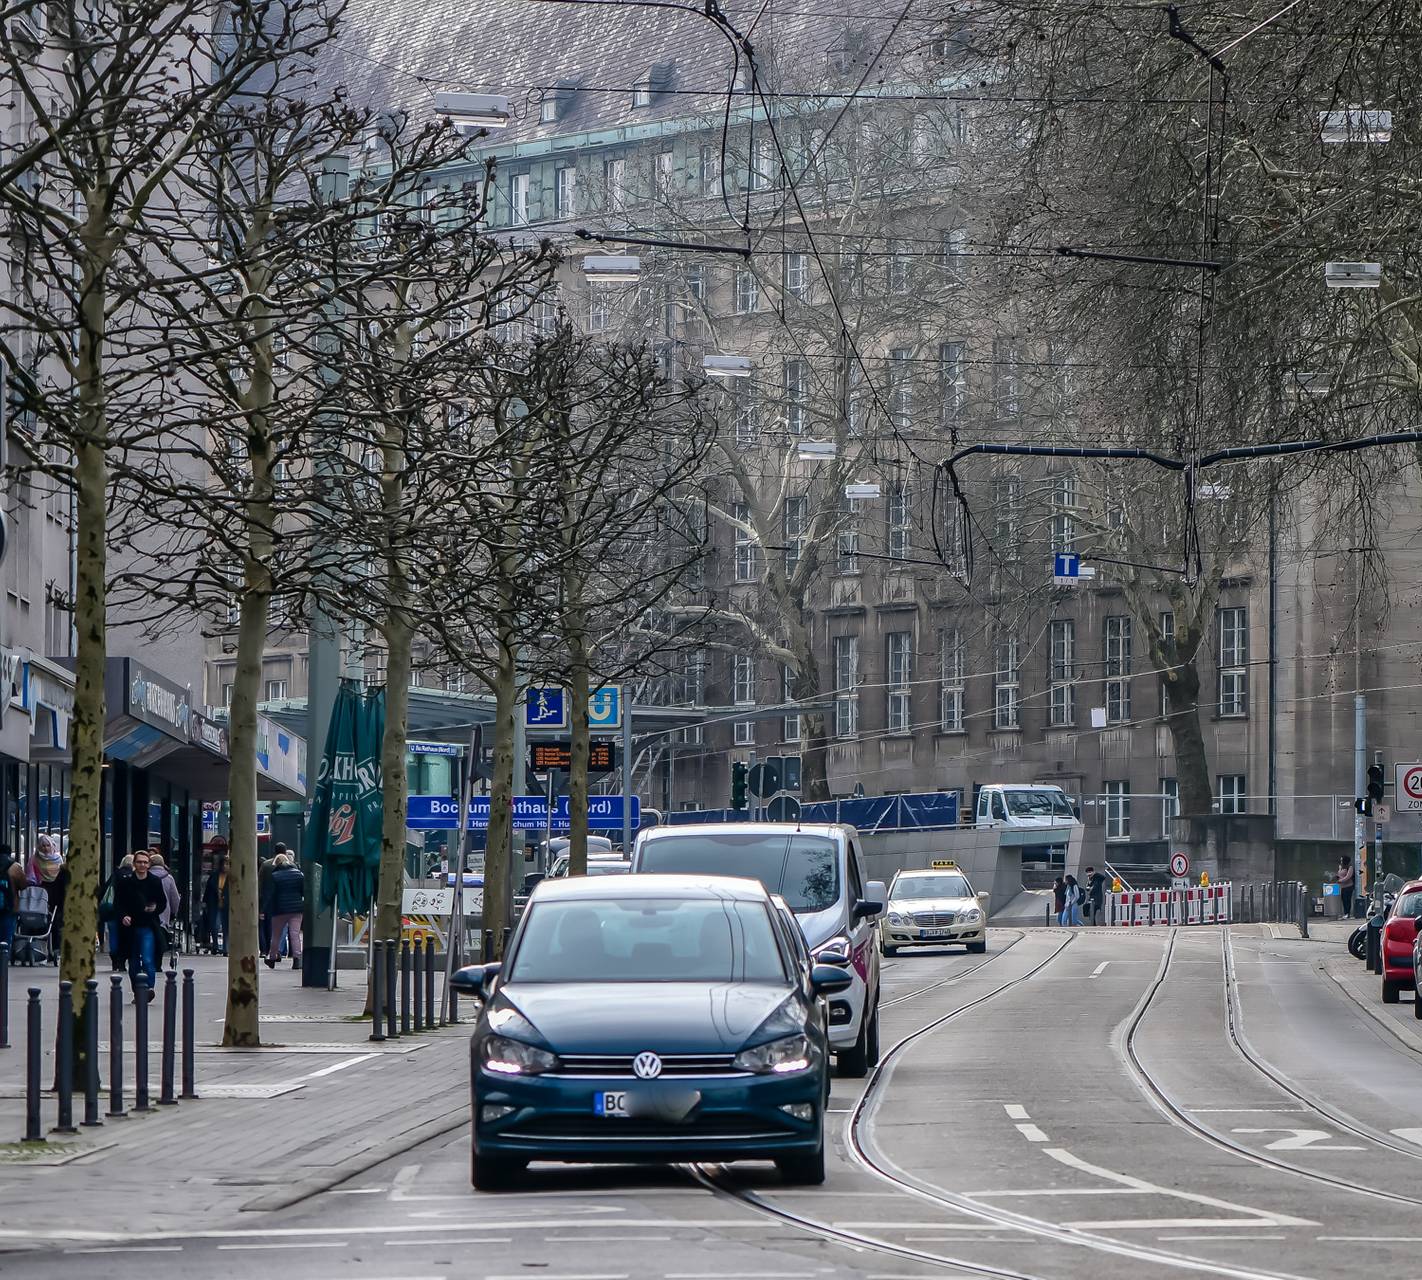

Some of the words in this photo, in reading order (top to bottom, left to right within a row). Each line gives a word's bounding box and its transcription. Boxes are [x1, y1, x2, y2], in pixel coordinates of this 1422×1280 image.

[1059, 554, 1075, 575] T
[430, 800, 491, 814] Bocum
[512, 800, 559, 814] athaus
